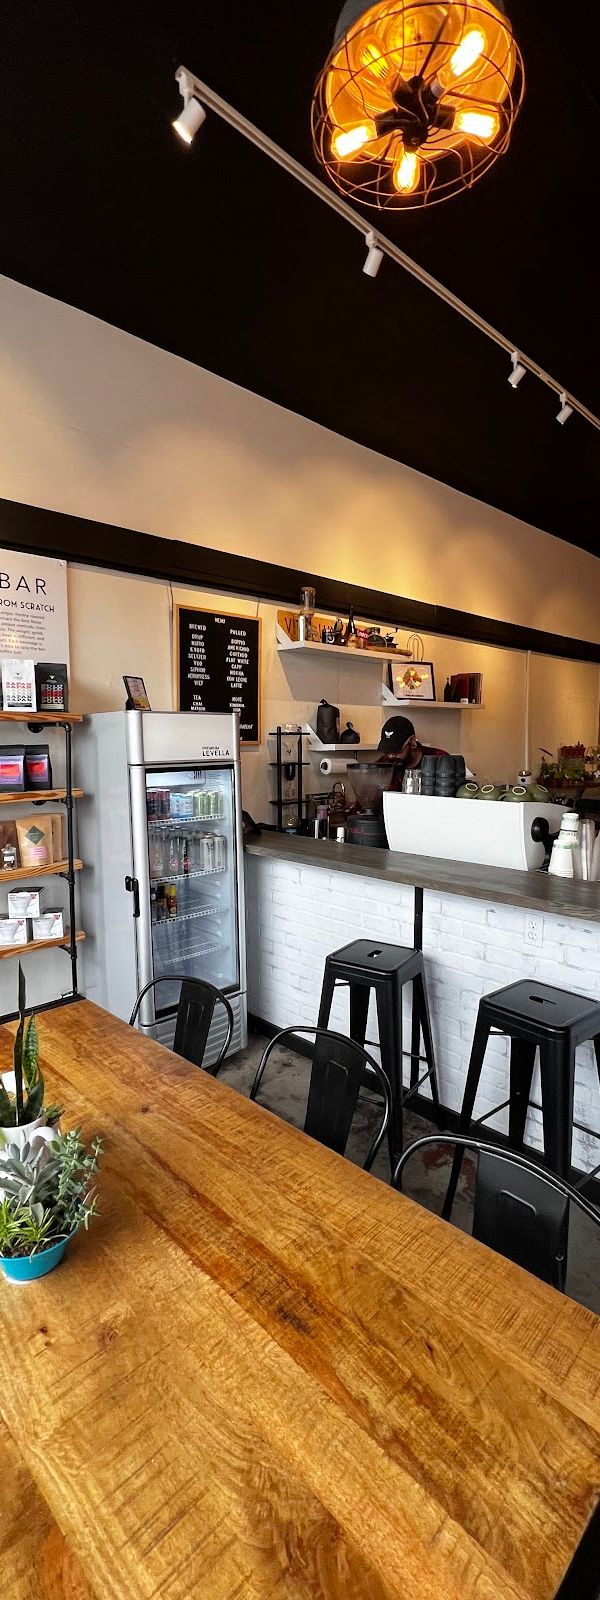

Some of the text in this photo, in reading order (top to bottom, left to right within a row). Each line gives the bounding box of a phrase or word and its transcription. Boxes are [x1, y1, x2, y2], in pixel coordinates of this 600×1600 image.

[0, 573, 47, 596] BAR
[20, 601, 55, 613] SCRATCH
[189, 623, 207, 631] BREWED
[229, 629, 247, 637] PULLED
[202, 749, 230, 757] LEVELLA
